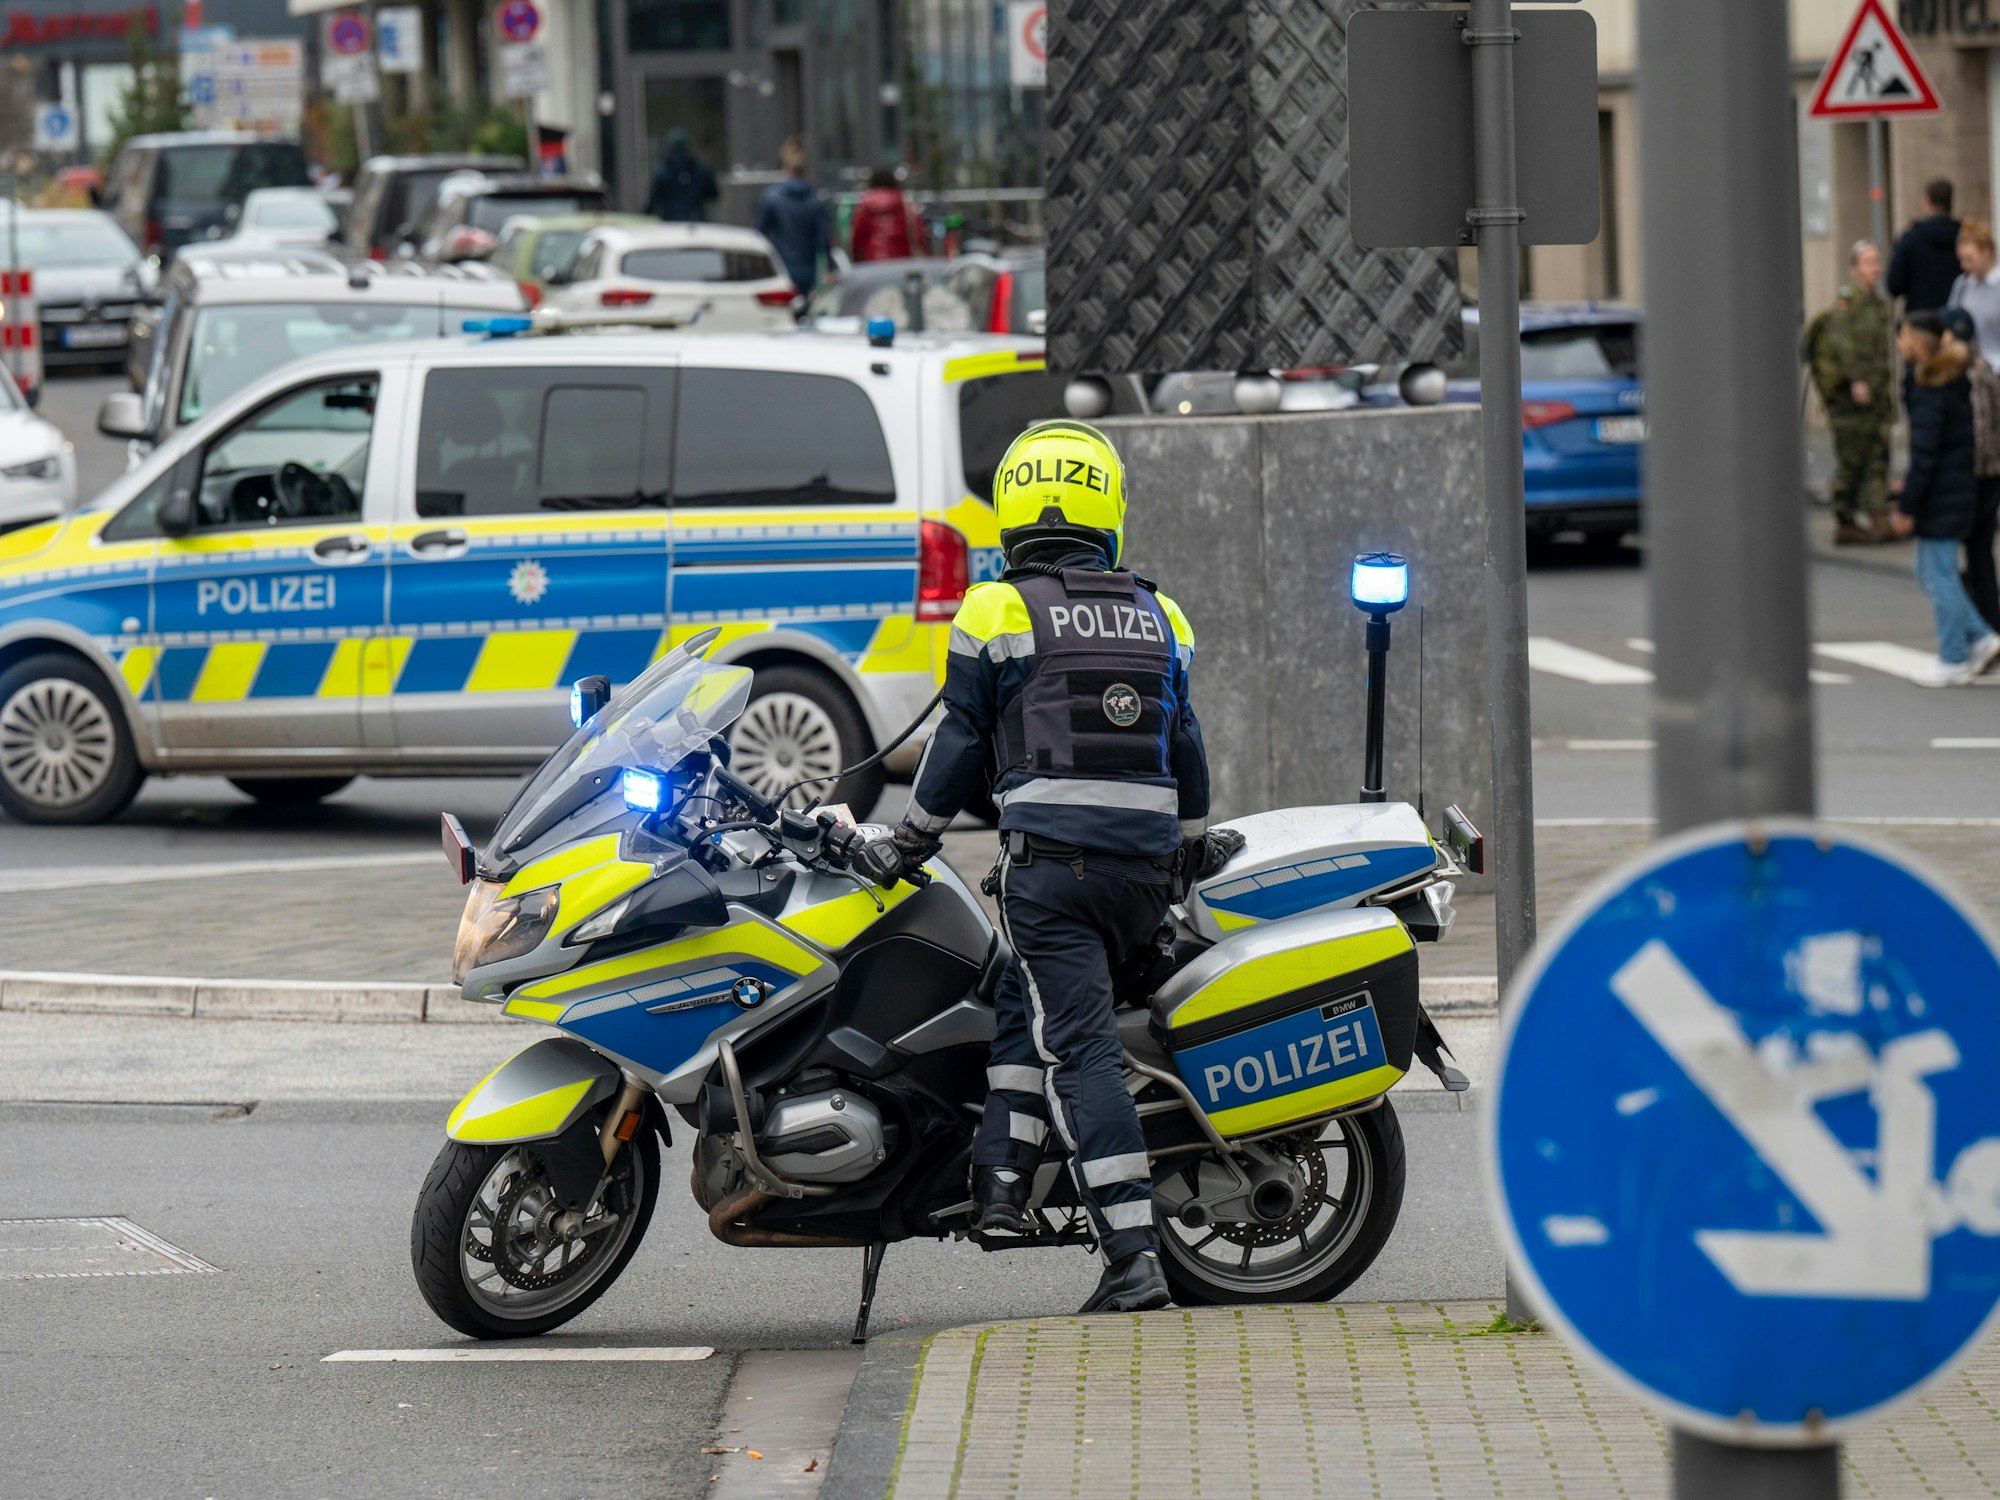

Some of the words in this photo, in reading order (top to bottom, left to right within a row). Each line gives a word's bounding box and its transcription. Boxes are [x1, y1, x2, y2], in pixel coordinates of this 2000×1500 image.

[1004, 458, 1109, 496] POLIZEI
[197, 574, 336, 616] POLIZEI
[1048, 604, 1165, 643] POLIZEI
[734, 979, 762, 992] BMW
[1332, 999, 1356, 1015] BMW
[1203, 1020, 1368, 1103] POLIZEI
